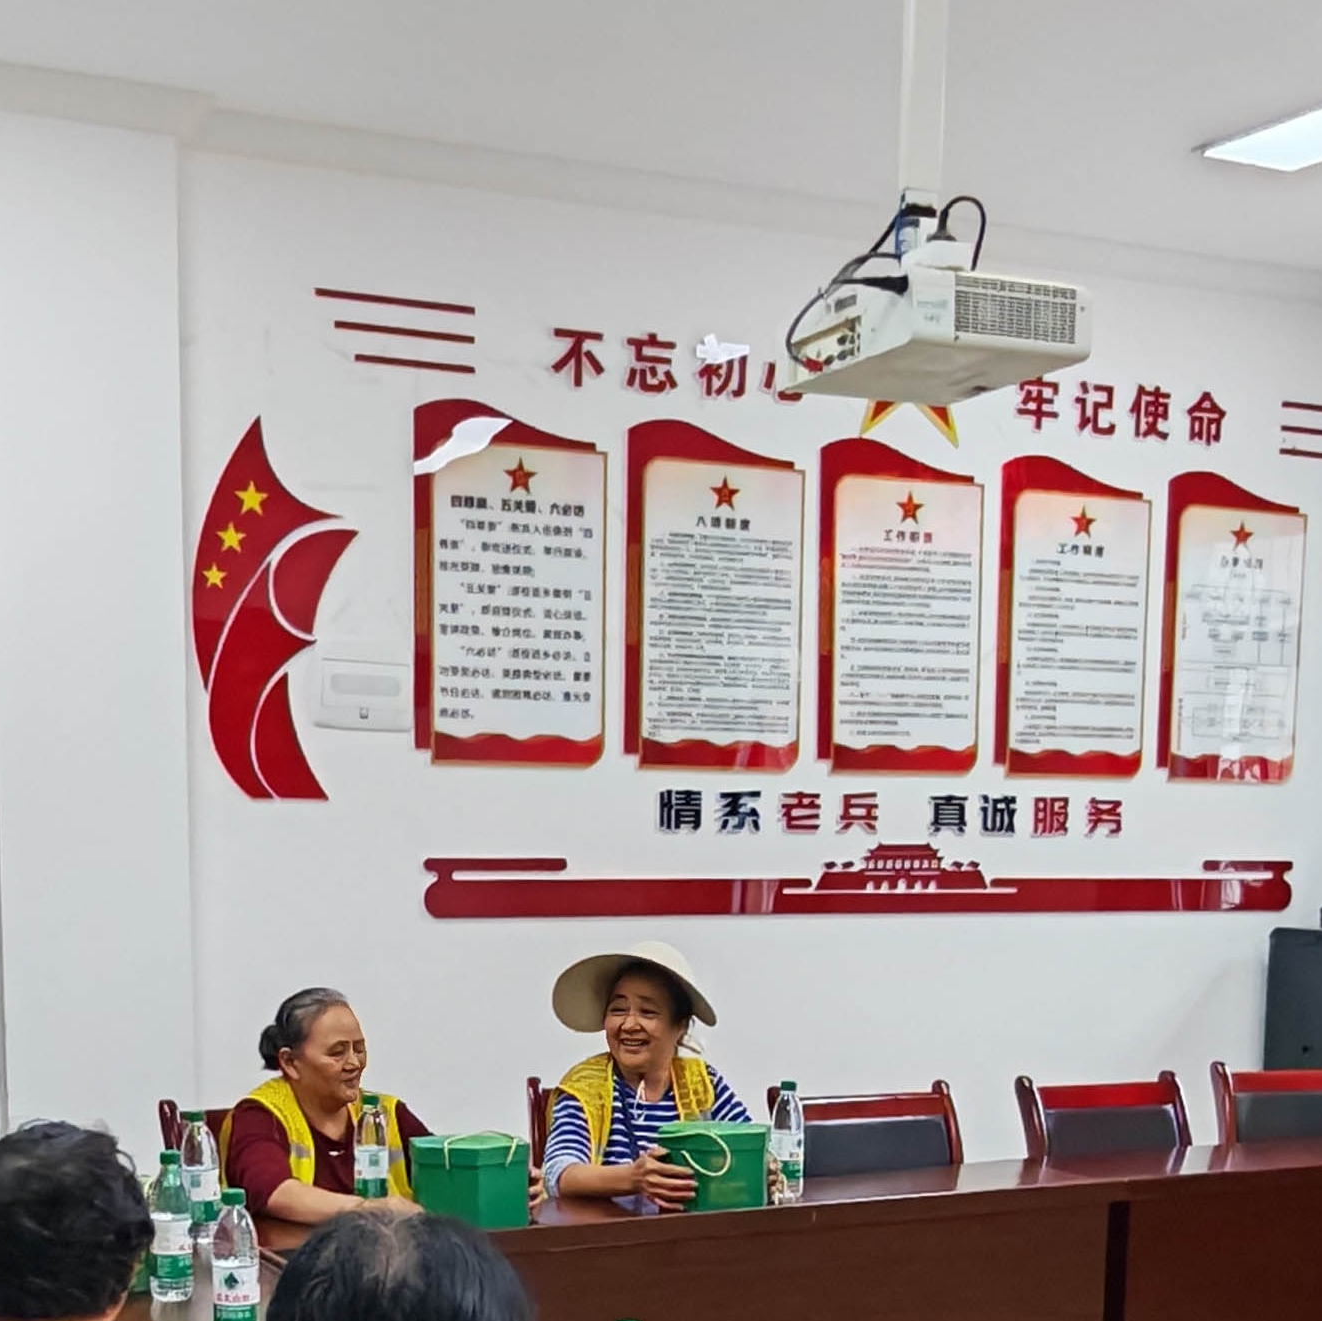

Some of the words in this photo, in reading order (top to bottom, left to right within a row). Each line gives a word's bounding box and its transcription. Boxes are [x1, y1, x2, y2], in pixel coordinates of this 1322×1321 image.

[1016, 377, 1228, 447] 牢记使命
[658, 789, 879, 834] 情系老兵
[927, 794, 1123, 837] 真诚服务
